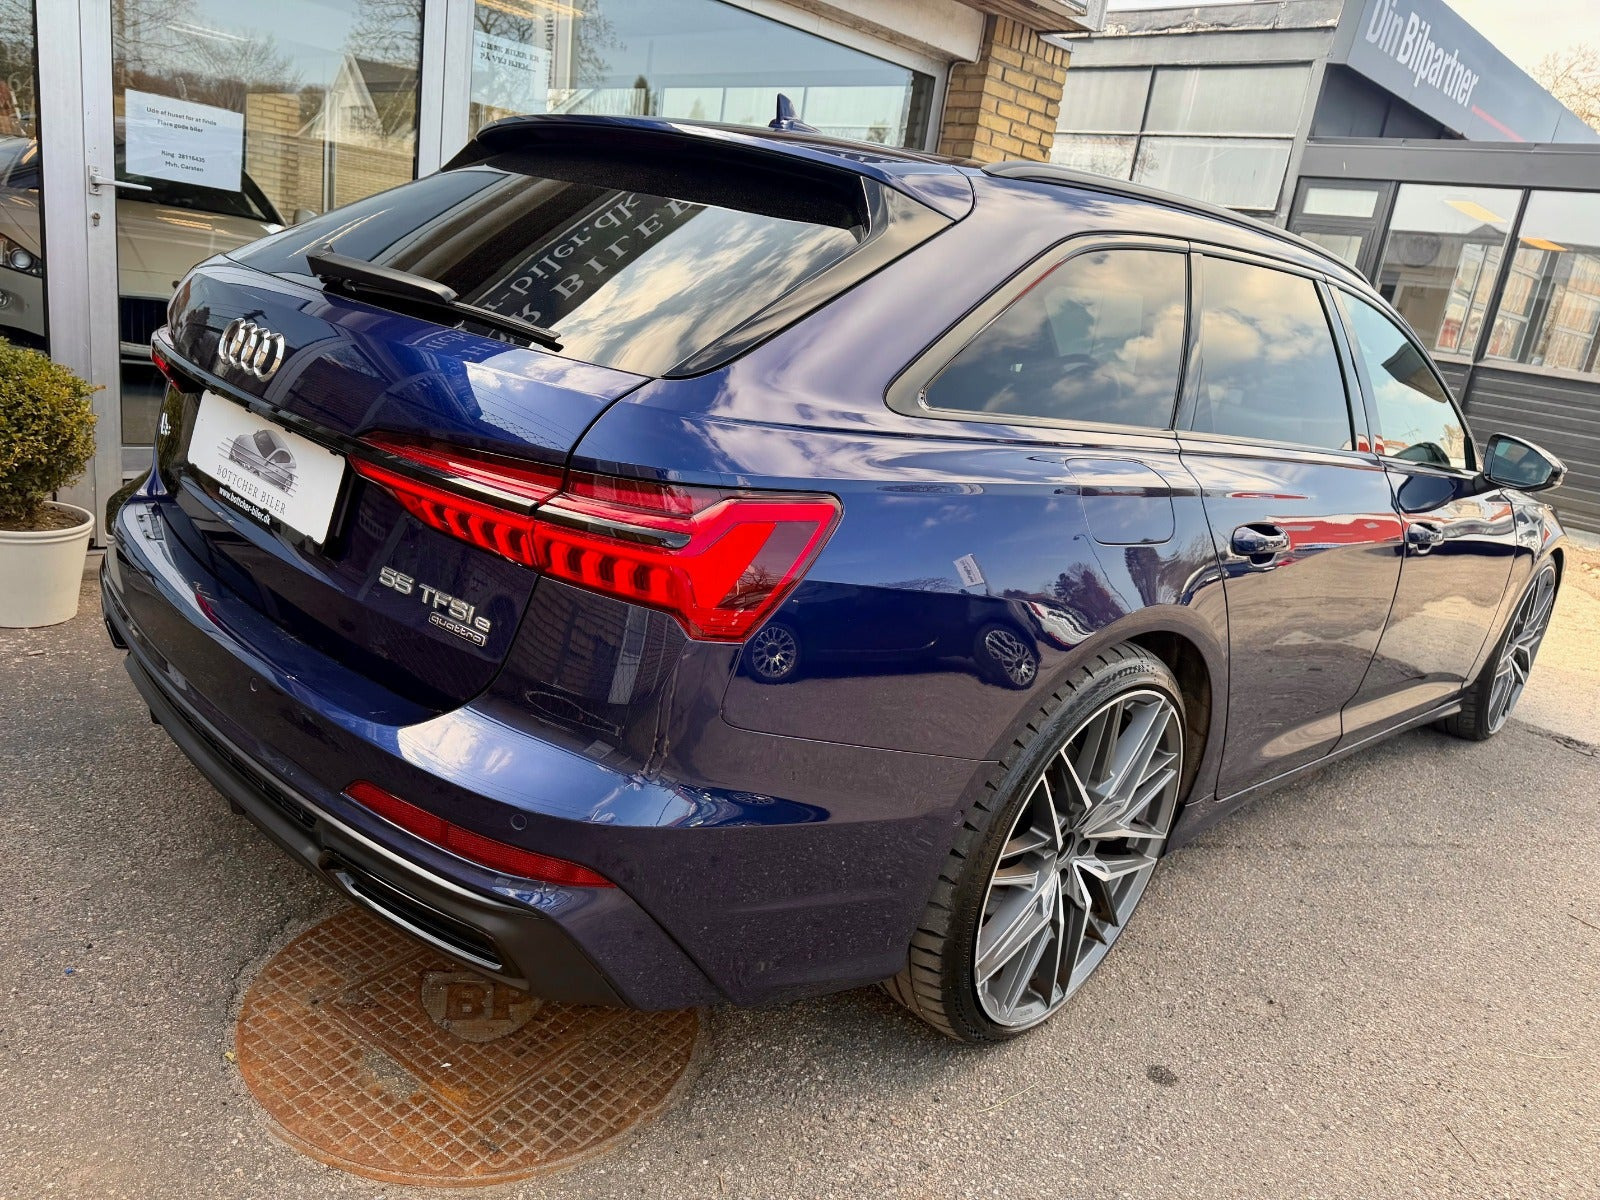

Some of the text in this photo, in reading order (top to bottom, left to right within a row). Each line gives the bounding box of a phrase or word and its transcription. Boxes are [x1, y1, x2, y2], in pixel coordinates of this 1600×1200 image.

[1366, 0, 1480, 107] Din Bilpartner
[260, 491, 286, 516] BILER
[379, 566, 415, 595] 55
[430, 614, 482, 644] quattro
